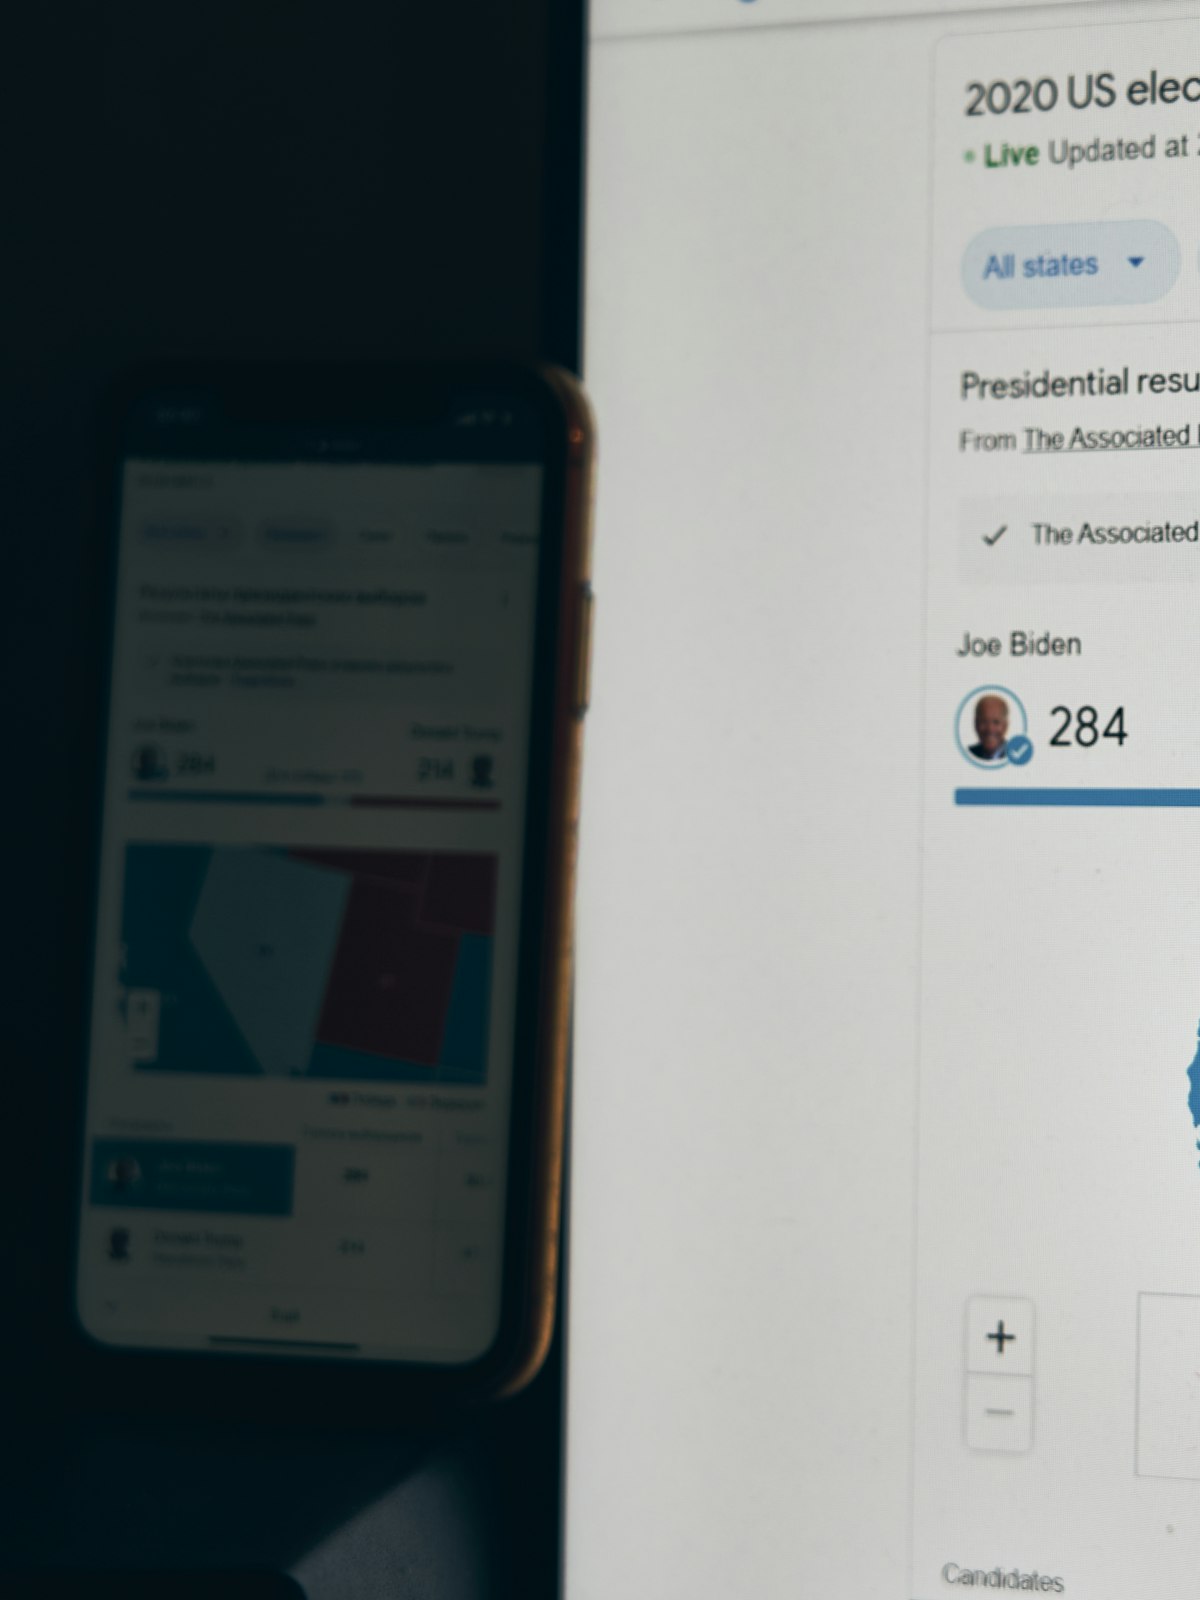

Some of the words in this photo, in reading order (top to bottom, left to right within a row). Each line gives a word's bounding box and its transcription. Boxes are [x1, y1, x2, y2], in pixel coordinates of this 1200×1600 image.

[966, 78, 1058, 116] 2020
[1068, 72, 1116, 109] US
[985, 145, 1039, 168] Live
[1049, 135, 1156, 168] Updated
[1165, 136, 1188, 157] at
[984, 255, 1014, 278] All
[1023, 255, 1098, 278] states
[962, 367, 1128, 399] Presidential
[960, 430, 1016, 451] From
[1026, 428, 1064, 452] The
[1069, 424, 1190, 450] Associated
[1034, 523, 1073, 544] The
[1078, 521, 1199, 544] Associated
[957, 634, 1001, 657] Joe
[1010, 631, 1081, 656] Biden
[1050, 706, 1127, 747] 284
[942, 1563, 1064, 1593] Candidates
